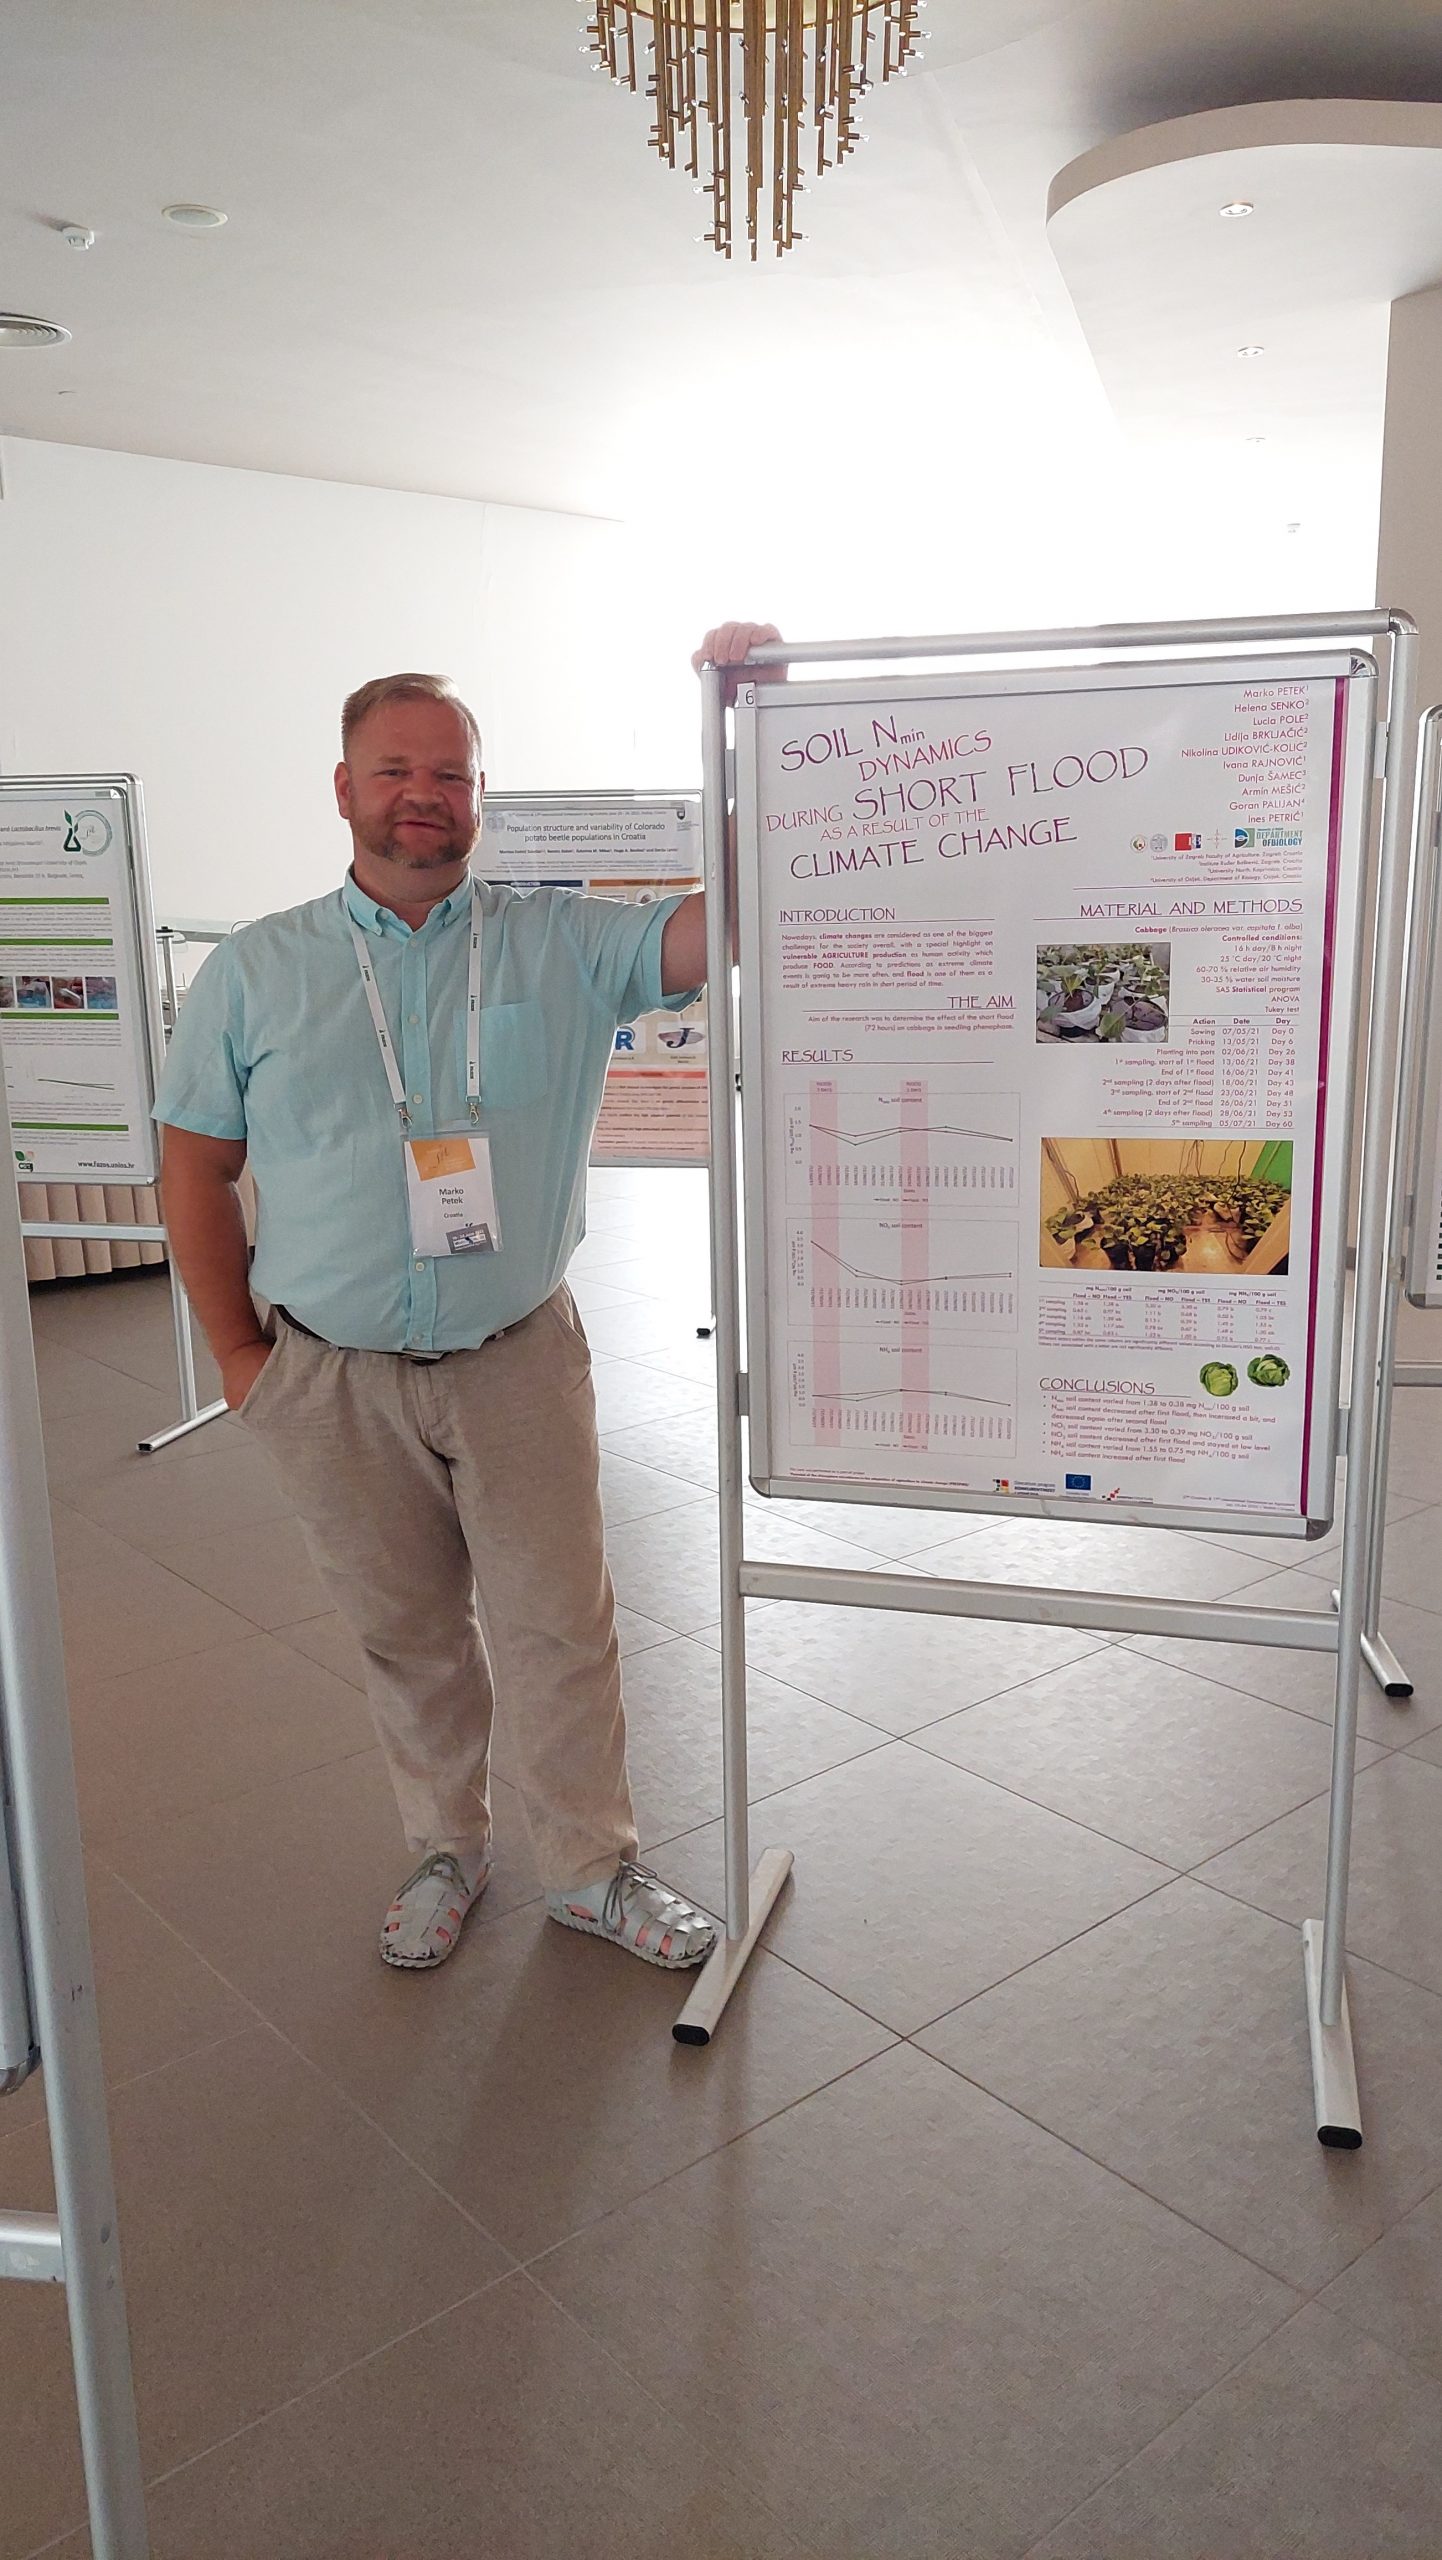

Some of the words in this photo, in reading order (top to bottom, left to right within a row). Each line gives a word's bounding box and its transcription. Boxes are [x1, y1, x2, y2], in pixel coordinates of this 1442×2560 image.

[745, 689, 754, 705] 6
[1244, 689, 1274, 698] Marko
[1235, 704, 1267, 712] Helena
[1254, 717, 1276, 726] Lucia
[1225, 733, 1248, 742] Lidija
[781, 728, 863, 771] SOIL
[1182, 747, 1218, 757] Nikolina
[859, 729, 992, 781] DYNAMICS
[1224, 761, 1248, 769] Ivana
[1239, 774, 1264, 783] Dunja
[766, 805, 843, 832] DURING
[853, 771, 986, 820] SHORT
[1008, 747, 1149, 796] FLOOD
[1242, 787, 1268, 795] Armin
[1230, 802, 1259, 810] Goran
[1249, 815, 1265, 823] Ines
[506, 824, 542, 832] Population
[542, 824, 574, 833] structure
[589, 823, 623, 831] variability
[624, 823, 632, 832] of
[632, 822, 665, 830] Colorado
[820, 828, 842, 842] AS
[847, 825, 858, 837] A
[862, 816, 922, 836] RESULT
[929, 813, 950, 828] OF
[955, 809, 989, 824] THE
[524, 834, 547, 842] potato
[547, 833, 570, 841] beetle
[620, 832, 646, 840] Croatia
[1256, 831, 1302, 839] DEPARTMENT
[791, 839, 924, 879] CLIMATE
[938, 817, 1077, 859] CHANGE
[1080, 903, 1161, 917] MATERIAL
[1170, 902, 1205, 914] AND
[1214, 899, 1302, 913] METHODS
[780, 908, 895, 922] INTRODUCTION
[1134, 926, 1168, 934] Cabbage
[844, 932, 872, 940] changes
[1283, 944, 1302, 952] night
[1283, 954, 1302, 962] night
[947, 996, 982, 1008] THE
[987, 996, 1013, 1008] AIM
[1264, 1006, 1285, 1014] Tukey
[1286, 1006, 1300, 1014] test
[1190, 1028, 1215, 1036] Sowing
[1271, 1027, 1286, 1035] Day
[666, 1028, 695, 1048] J
[1187, 1038, 1215, 1046] Pricking
[1270, 1038, 1286, 1046] Day
[782, 1049, 853, 1062] RESULTS
[1156, 1048, 1184, 1056] Planting
[1268, 1048, 1283, 1056] Day
[1267, 1068, 1283, 1076] Day
[1181, 1120, 1213, 1128] sampling
[1218, 1119, 1256, 1128] 05/07/21
[1265, 1120, 1281, 1128] Day
[1281, 1120, 1293, 1128] 60
[1040, 1378, 1155, 1394] CONCLUSIONS
[1050, 1413, 1085, 1423] decreased
